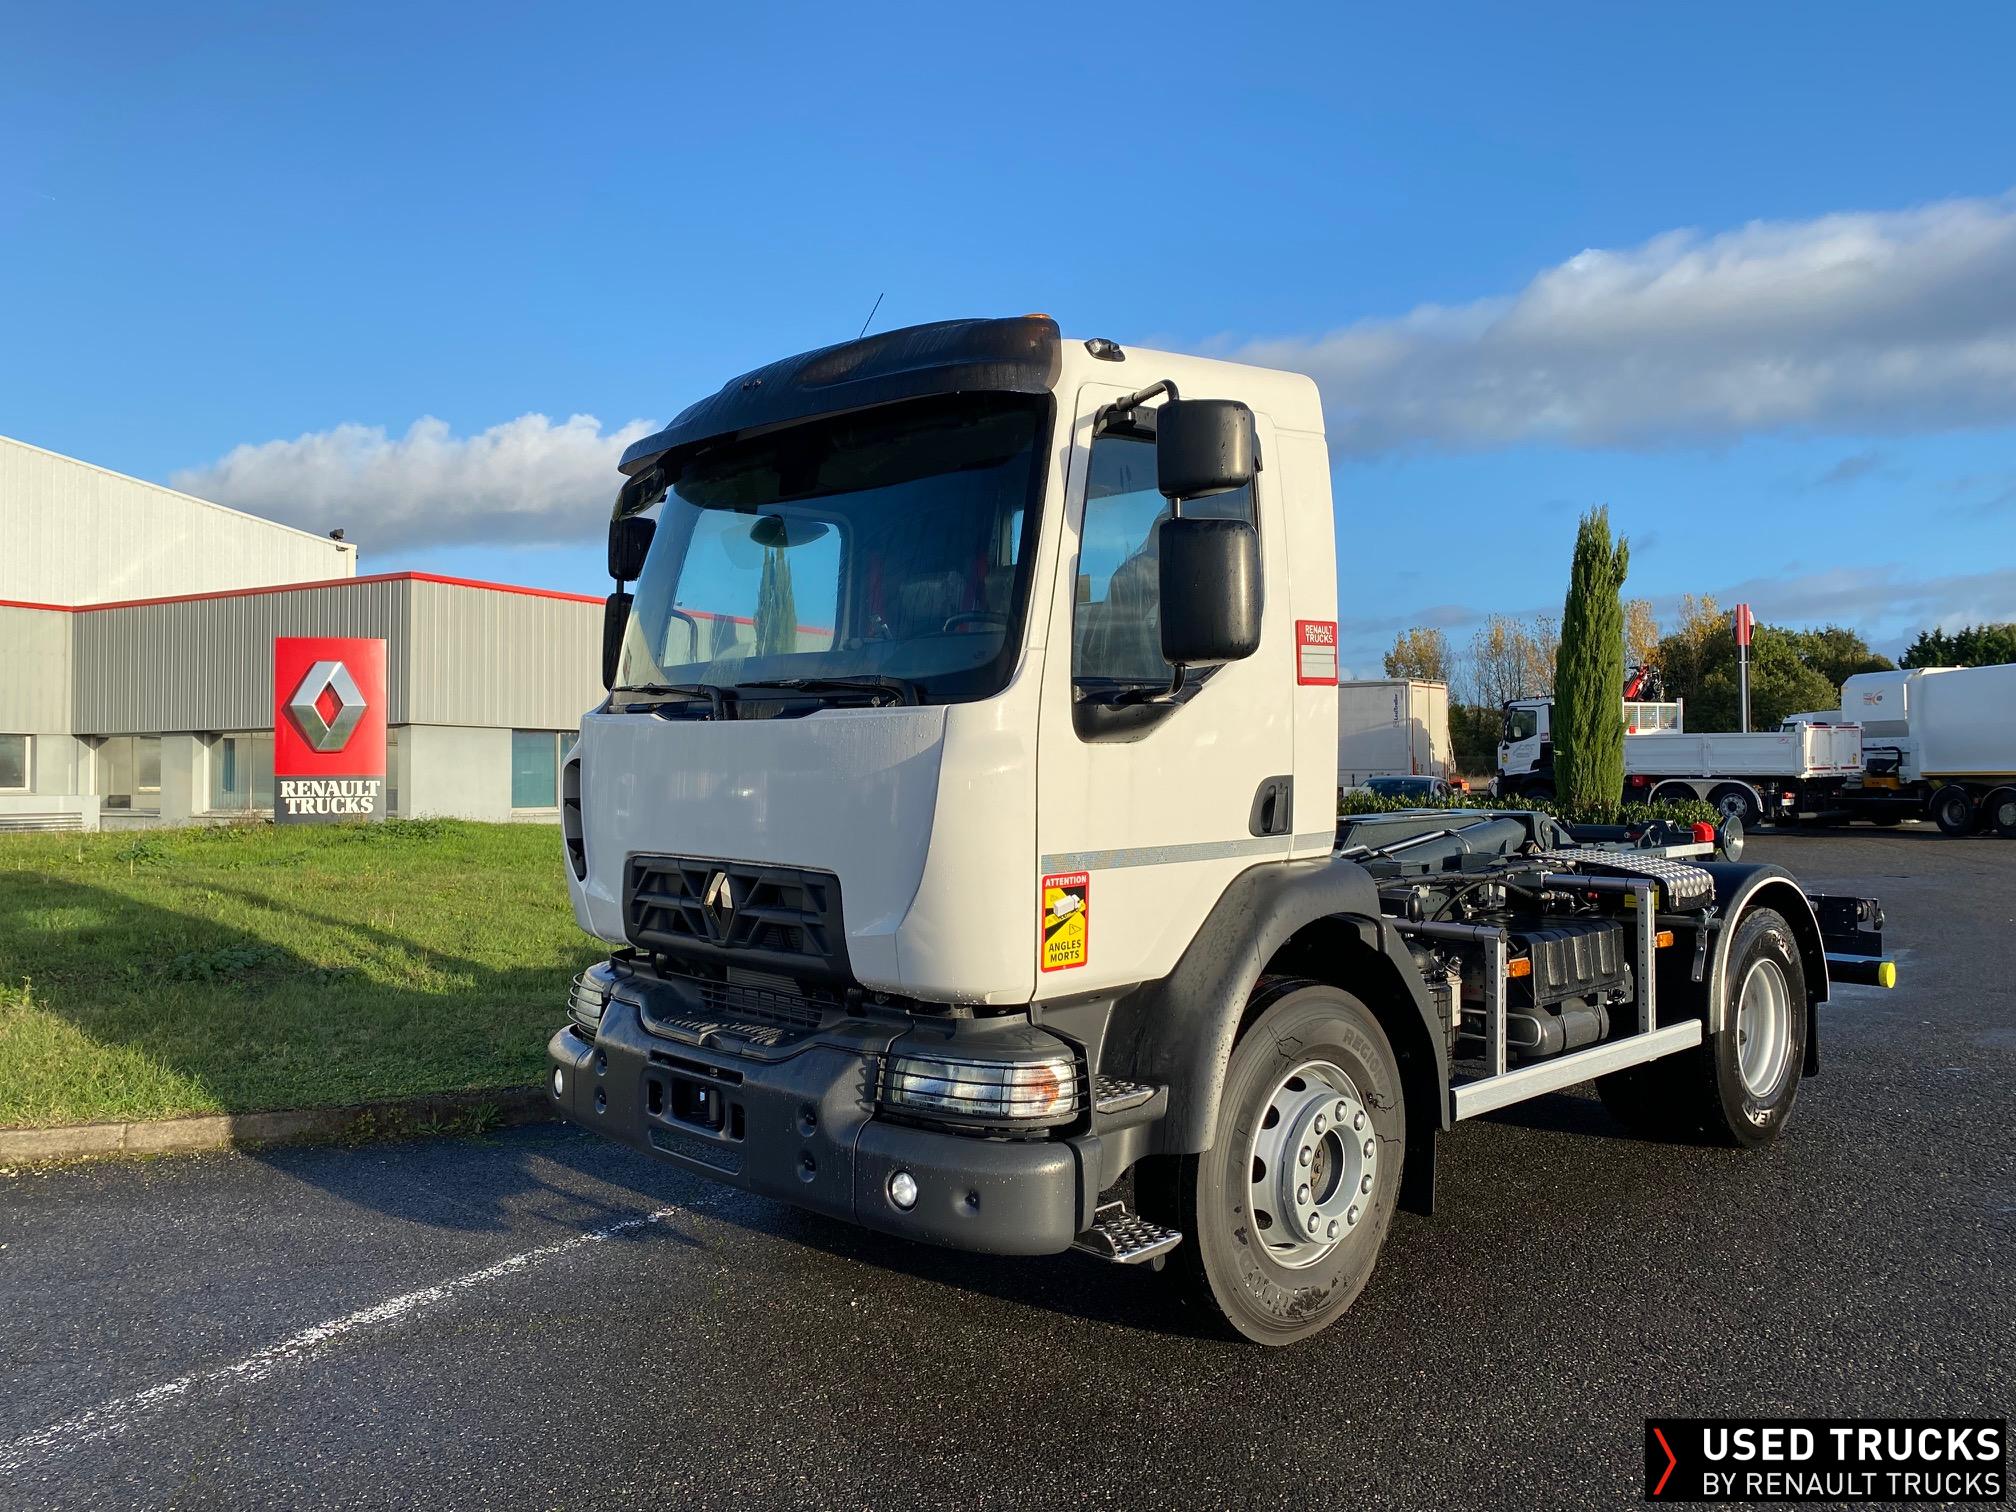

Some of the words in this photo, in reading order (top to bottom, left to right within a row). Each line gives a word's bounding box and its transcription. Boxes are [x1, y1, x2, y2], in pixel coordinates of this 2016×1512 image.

[1304, 624, 1333, 635] RENAULT
[1305, 633, 1334, 643] TRUCKS
[280, 780, 381, 798] RENAULT
[286, 797, 374, 815] TRUCKS
[1045, 875, 1087, 887] ATTENTION
[1048, 939, 1082, 953] ANGLES
[1050, 950, 1080, 963] MORTS
